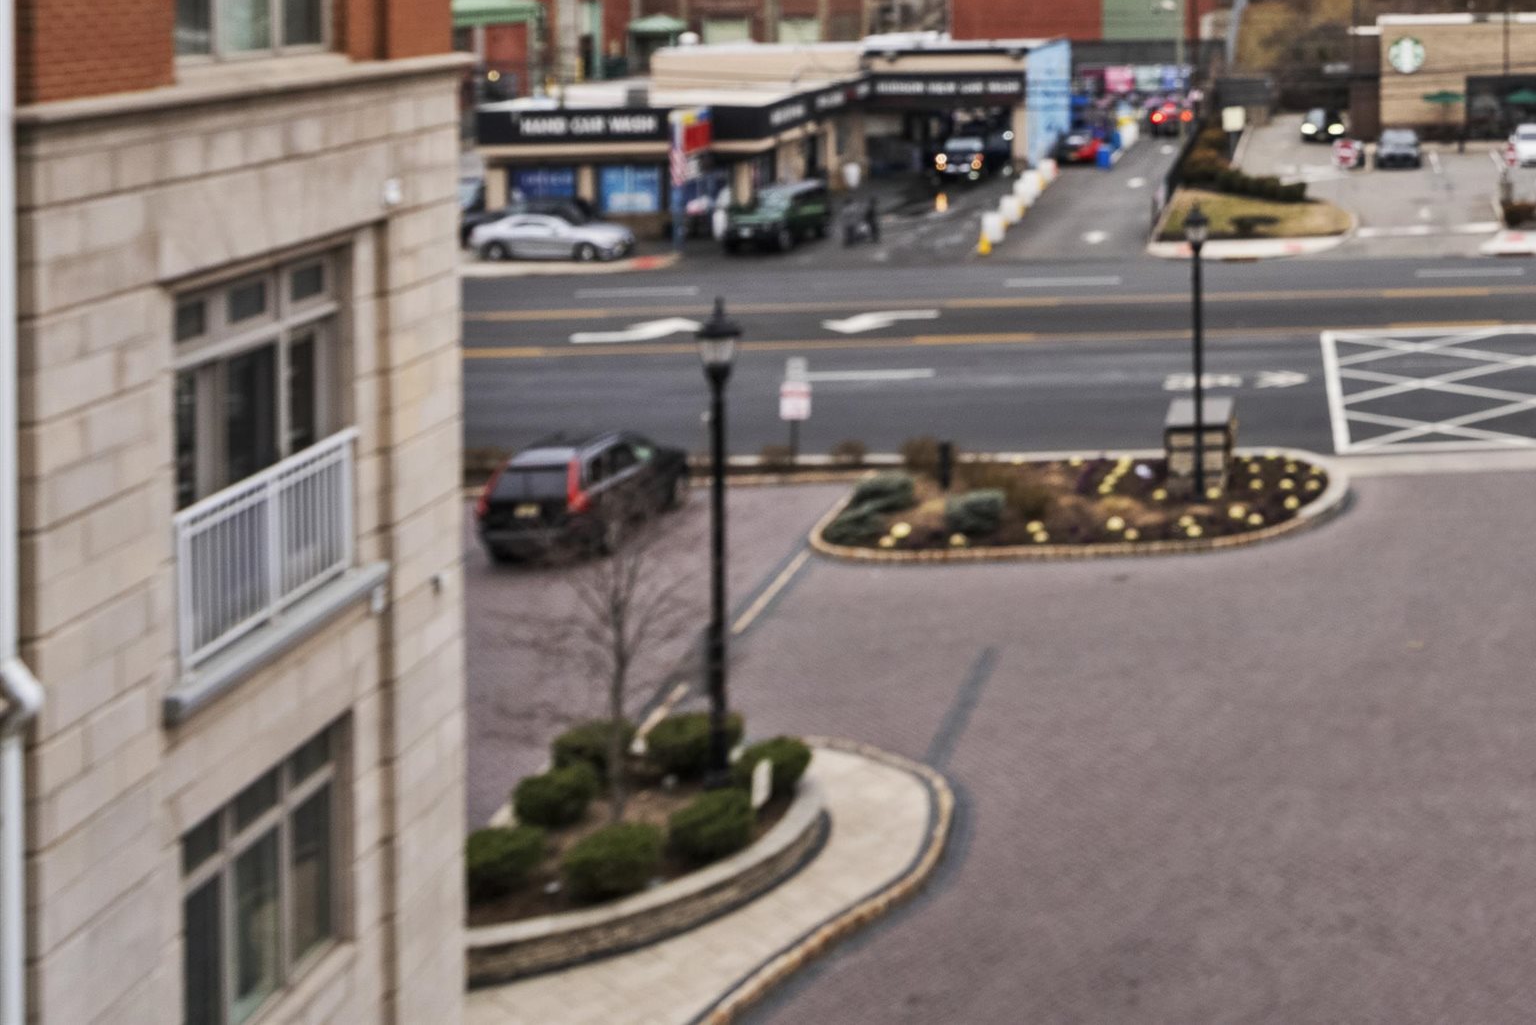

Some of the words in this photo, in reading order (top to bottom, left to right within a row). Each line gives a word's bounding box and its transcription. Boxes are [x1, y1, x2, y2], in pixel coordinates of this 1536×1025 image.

[520, 117, 566, 134] HAND
[571, 116, 606, 134] CAR
[609, 115, 658, 133] WASH
